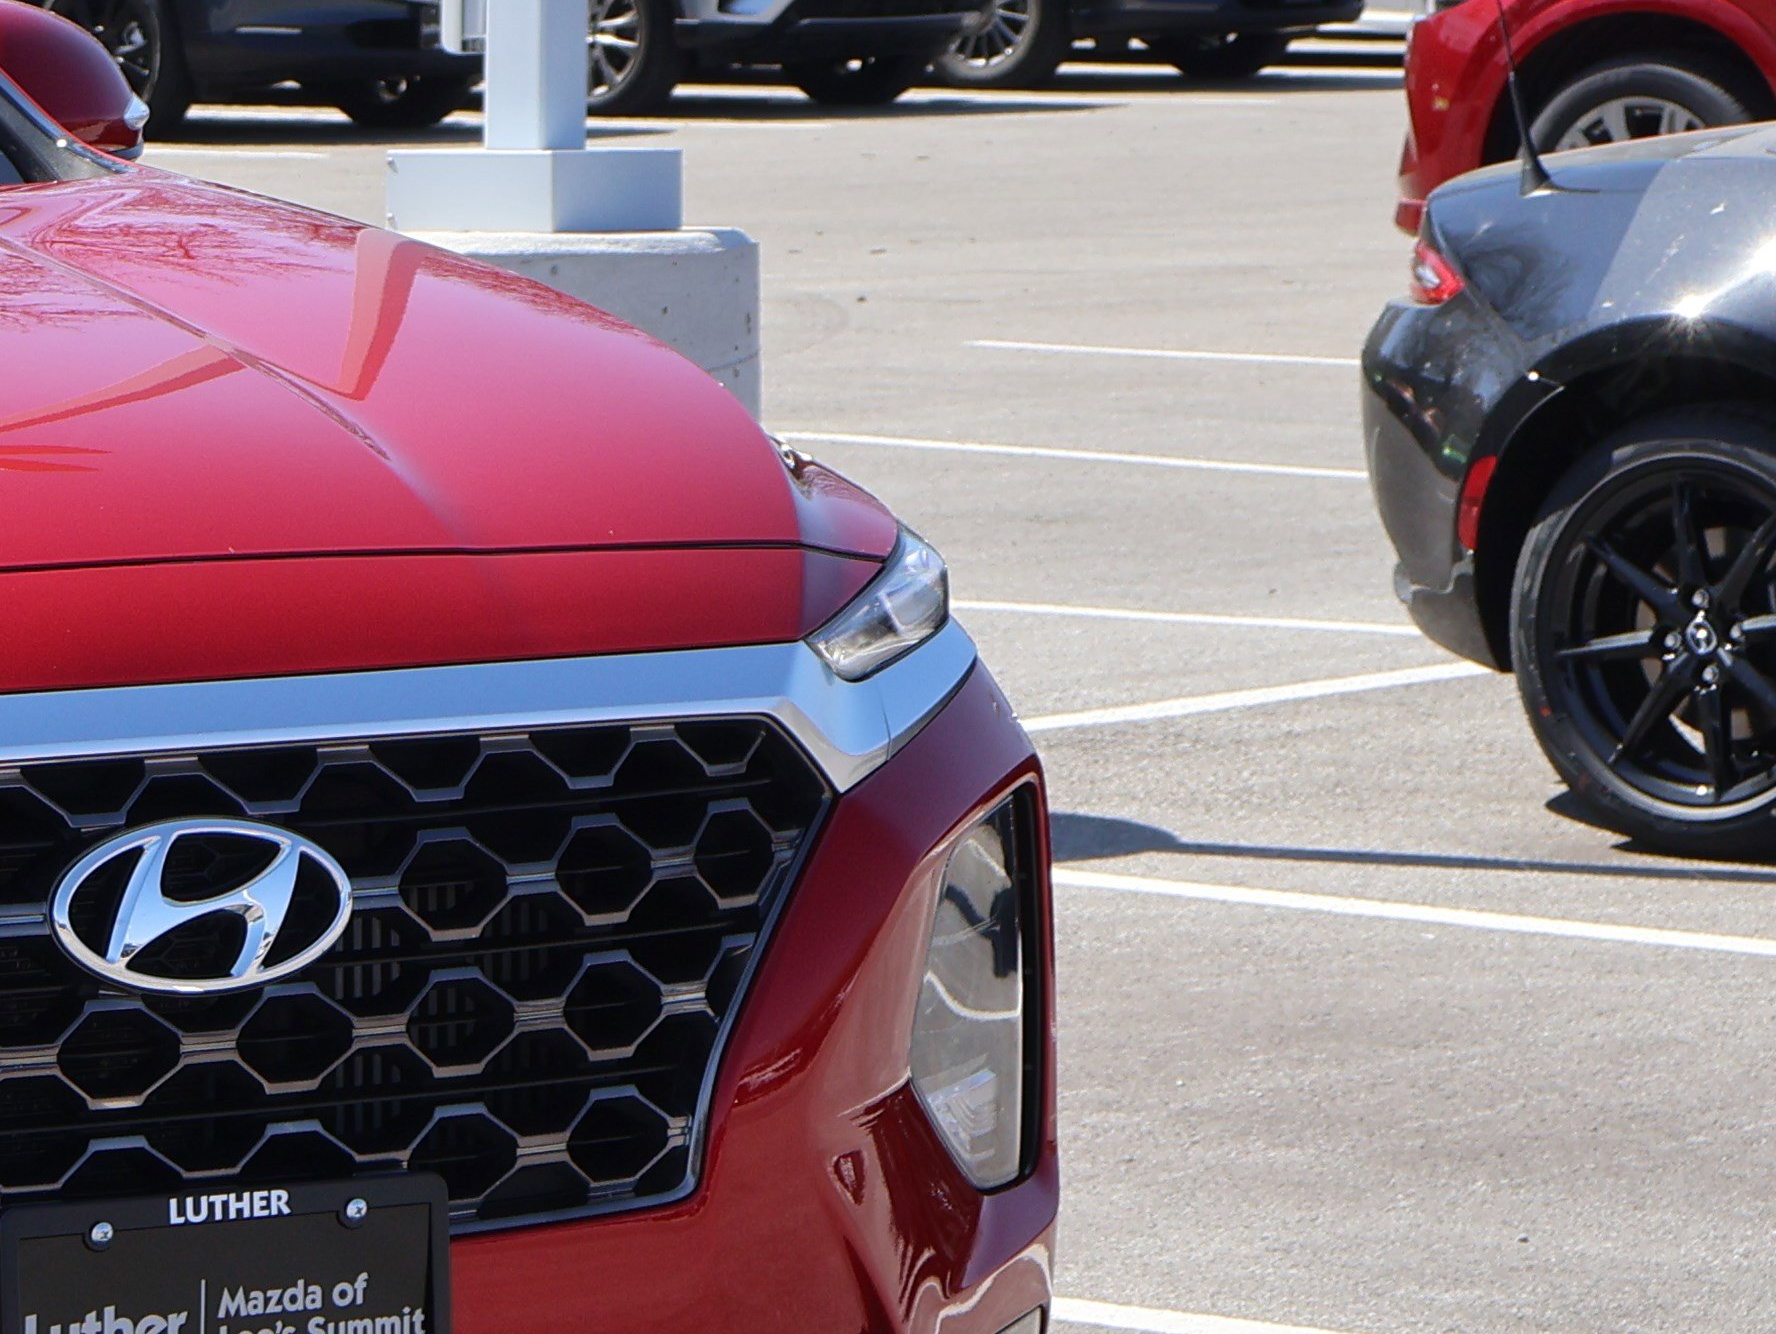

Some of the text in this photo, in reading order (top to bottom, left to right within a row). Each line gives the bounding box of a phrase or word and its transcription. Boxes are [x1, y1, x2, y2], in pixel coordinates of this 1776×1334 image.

[168, 1189, 292, 1225] LUTHER
[216, 1271, 370, 1320] Mazda of
